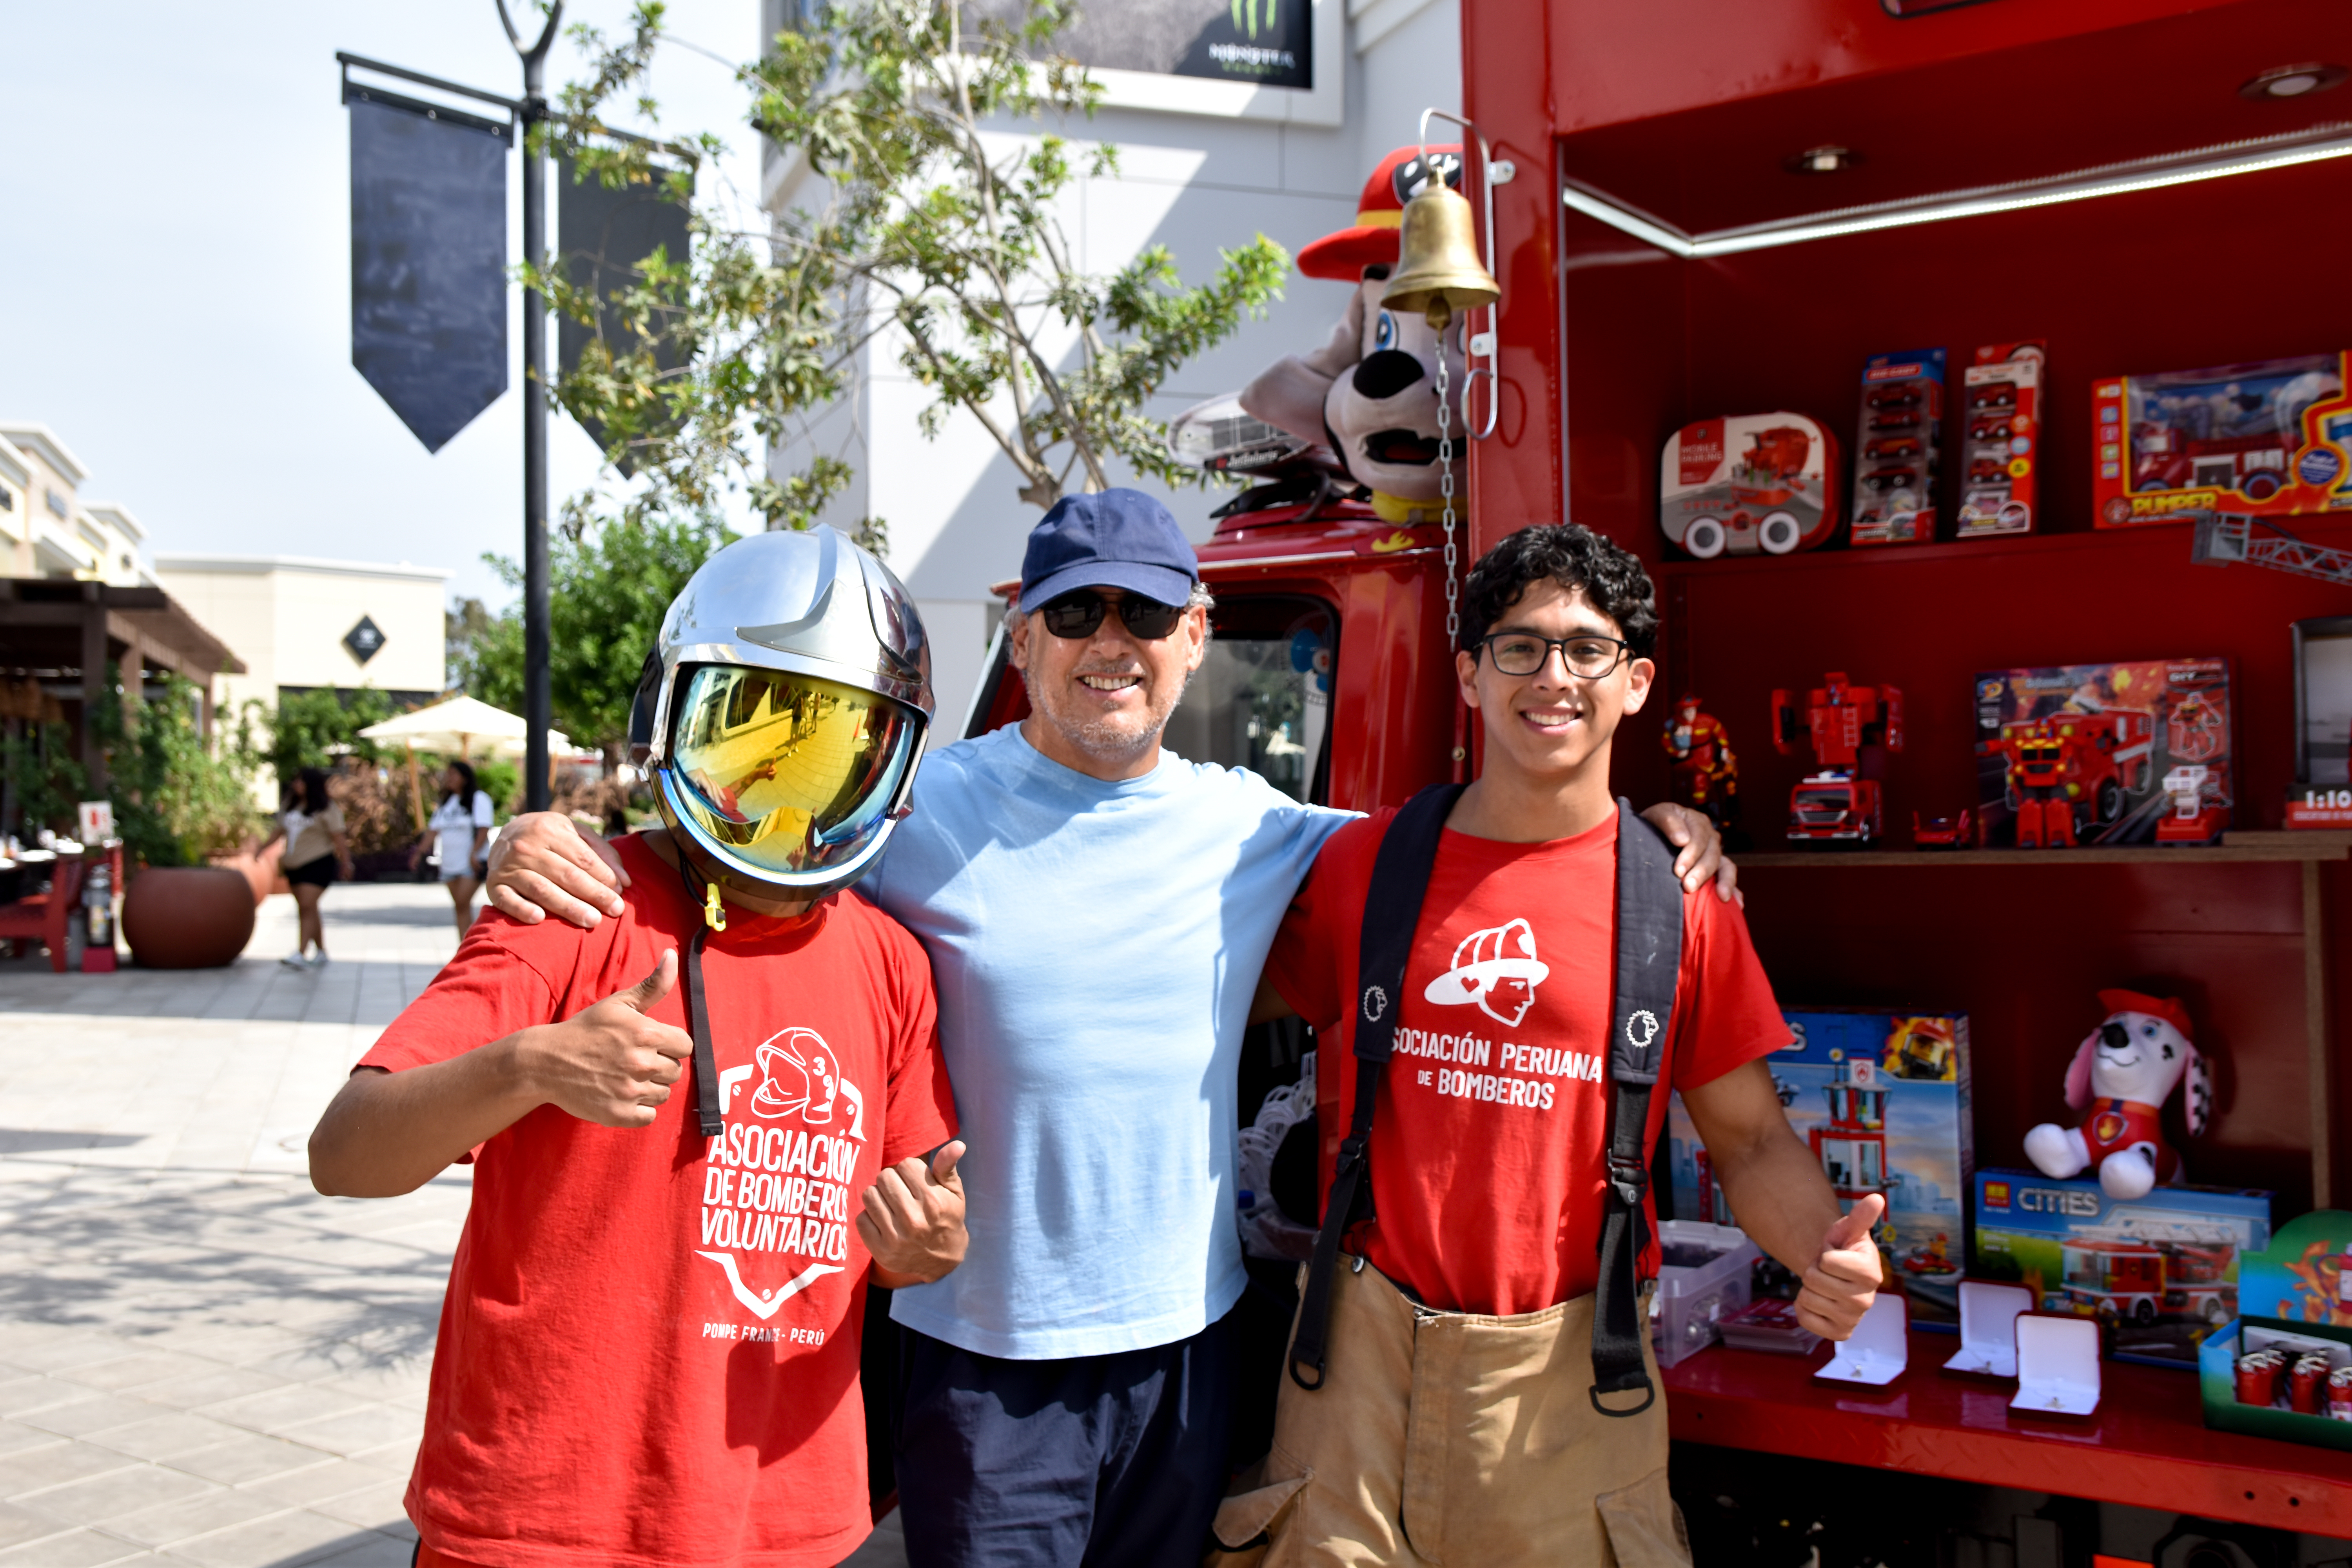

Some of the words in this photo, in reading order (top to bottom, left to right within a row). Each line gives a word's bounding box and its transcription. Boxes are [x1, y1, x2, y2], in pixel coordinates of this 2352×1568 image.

[1391, 1026, 1491, 1067] SOCIACIÓN
[1499, 1042, 1602, 1083] PERUANA
[1417, 1069, 1433, 1086] DE
[1437, 1068, 1555, 1110] BOMBEROS
[707, 1121, 860, 1185] ASOCIACIÓN
[703, 1166, 737, 1206] DE
[737, 1171, 848, 1223] BOMBEROS
[2017, 1187, 2101, 1217] CITIES
[702, 1206, 848, 1261] VOLUNTARIOS
[789, 1328, 825, 1346] PERÚ
